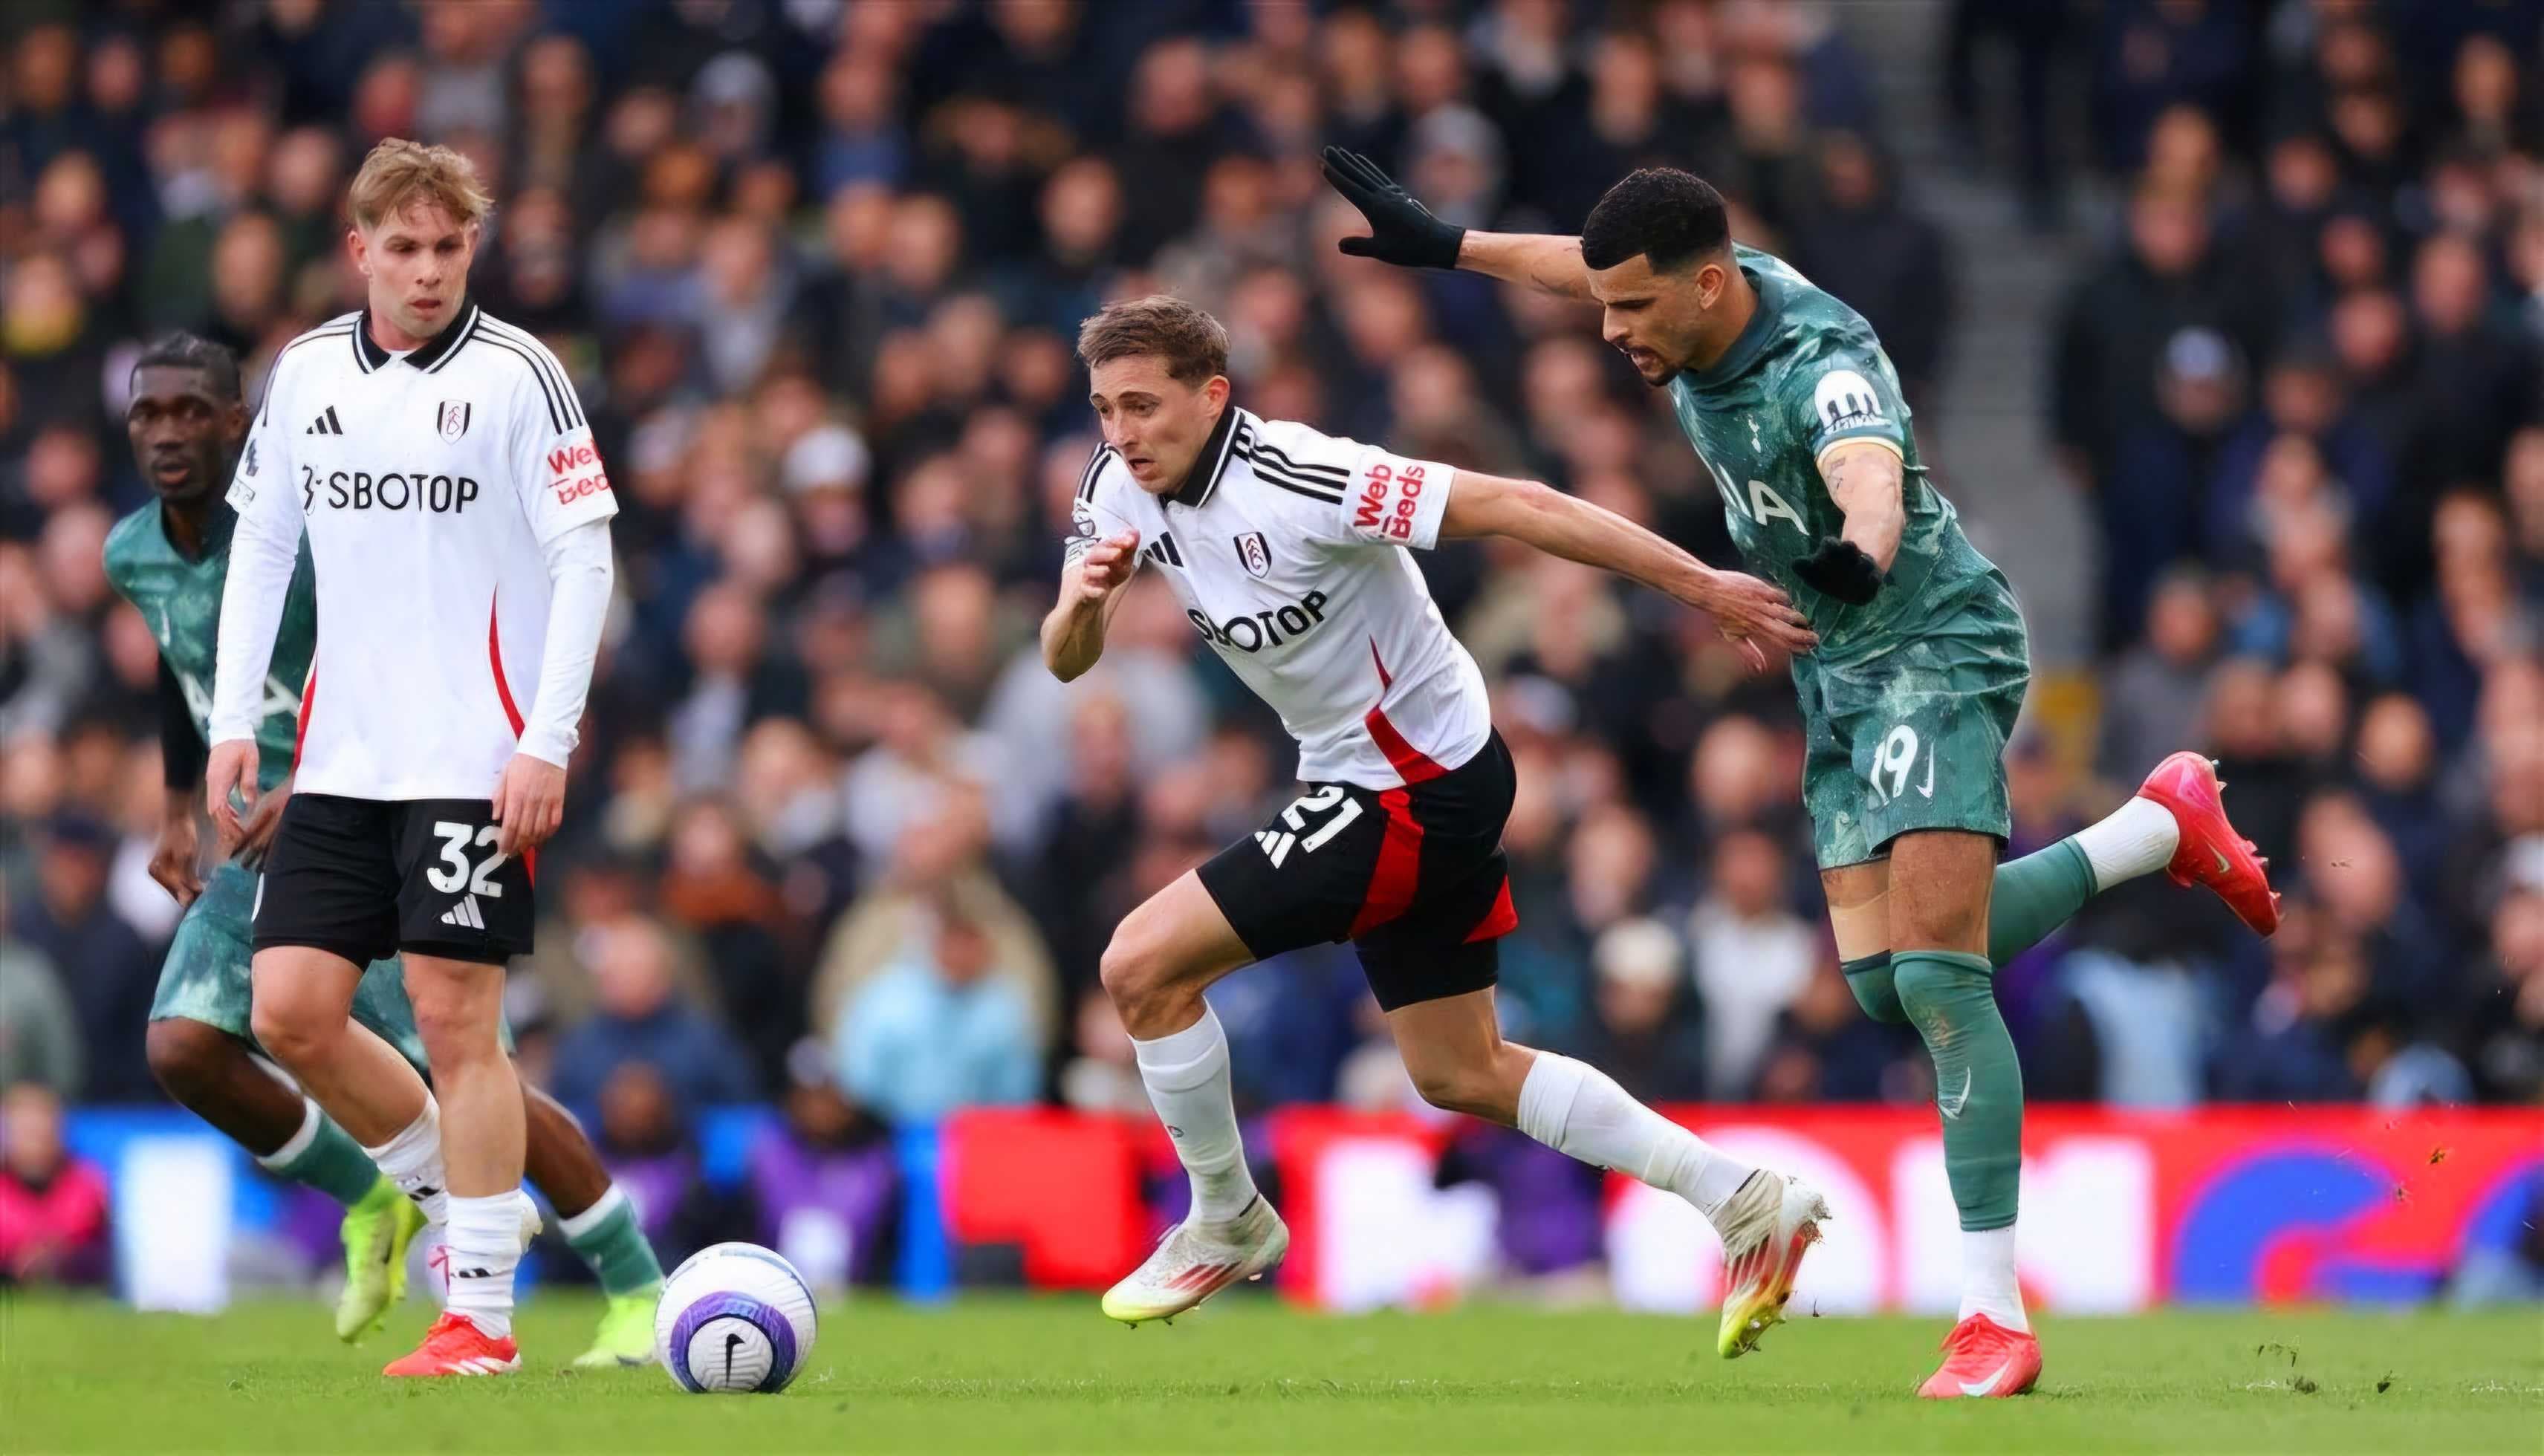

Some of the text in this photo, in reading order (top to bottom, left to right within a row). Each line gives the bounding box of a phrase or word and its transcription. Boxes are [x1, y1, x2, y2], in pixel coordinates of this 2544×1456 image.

[328, 472, 479, 513] SBOTOP
[1353, 464, 1392, 527] Web
[1390, 466, 1426, 539] Beds
[1870, 724, 1918, 806] 19
[1281, 785, 1363, 854] 21
[426, 821, 509, 898] 32
